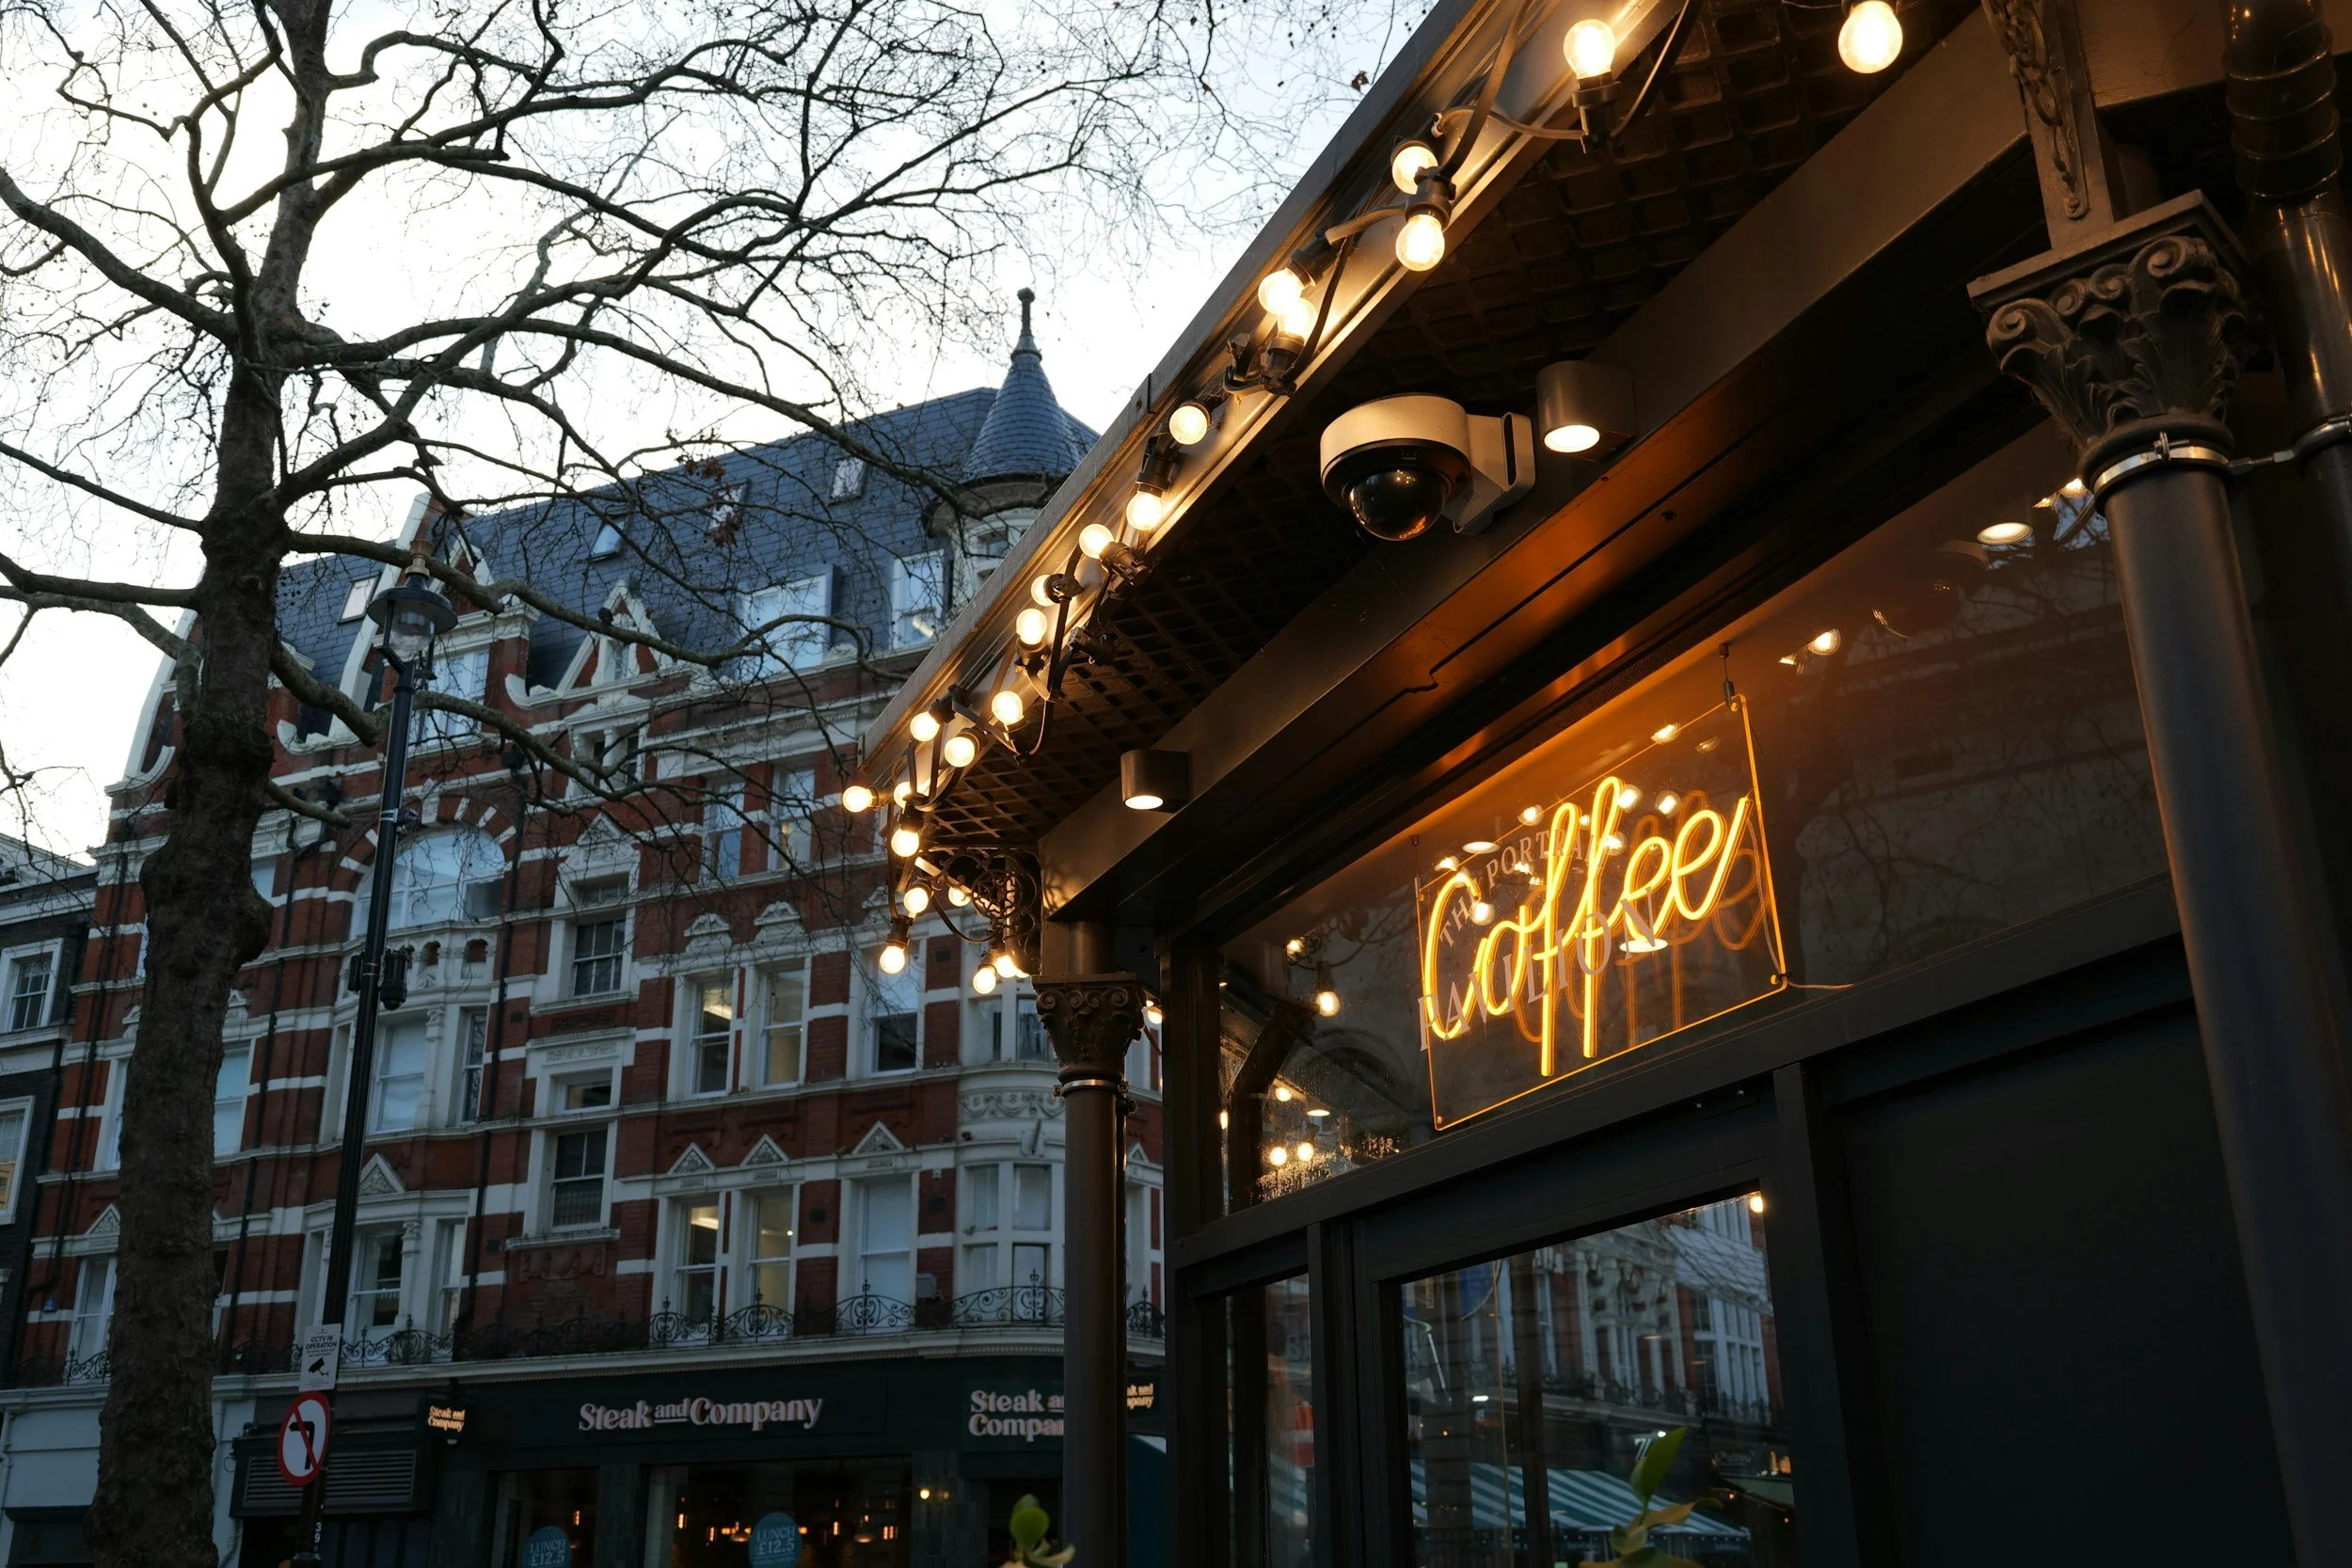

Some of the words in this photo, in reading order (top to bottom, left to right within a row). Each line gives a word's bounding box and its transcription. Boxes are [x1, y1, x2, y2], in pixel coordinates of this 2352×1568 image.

[1424, 776, 1753, 1076] Coffee
[1417, 886, 1656, 1052] PAVILION
[305, 1341, 338, 1350] OPERATION
[310, 1335, 326, 1343] CCTV
[970, 1388, 1045, 1413] Steak
[429, 1405, 452, 1418] Steak
[579, 1400, 653, 1431] Steak
[654, 1398, 691, 1422] and
[690, 1397, 824, 1432] Company
[428, 1416, 466, 1433] Company
[968, 1414, 1064, 1442] Compa
[756, 1526, 796, 1543] LUNCH
[530, 1539, 566, 1555] LUNCH
